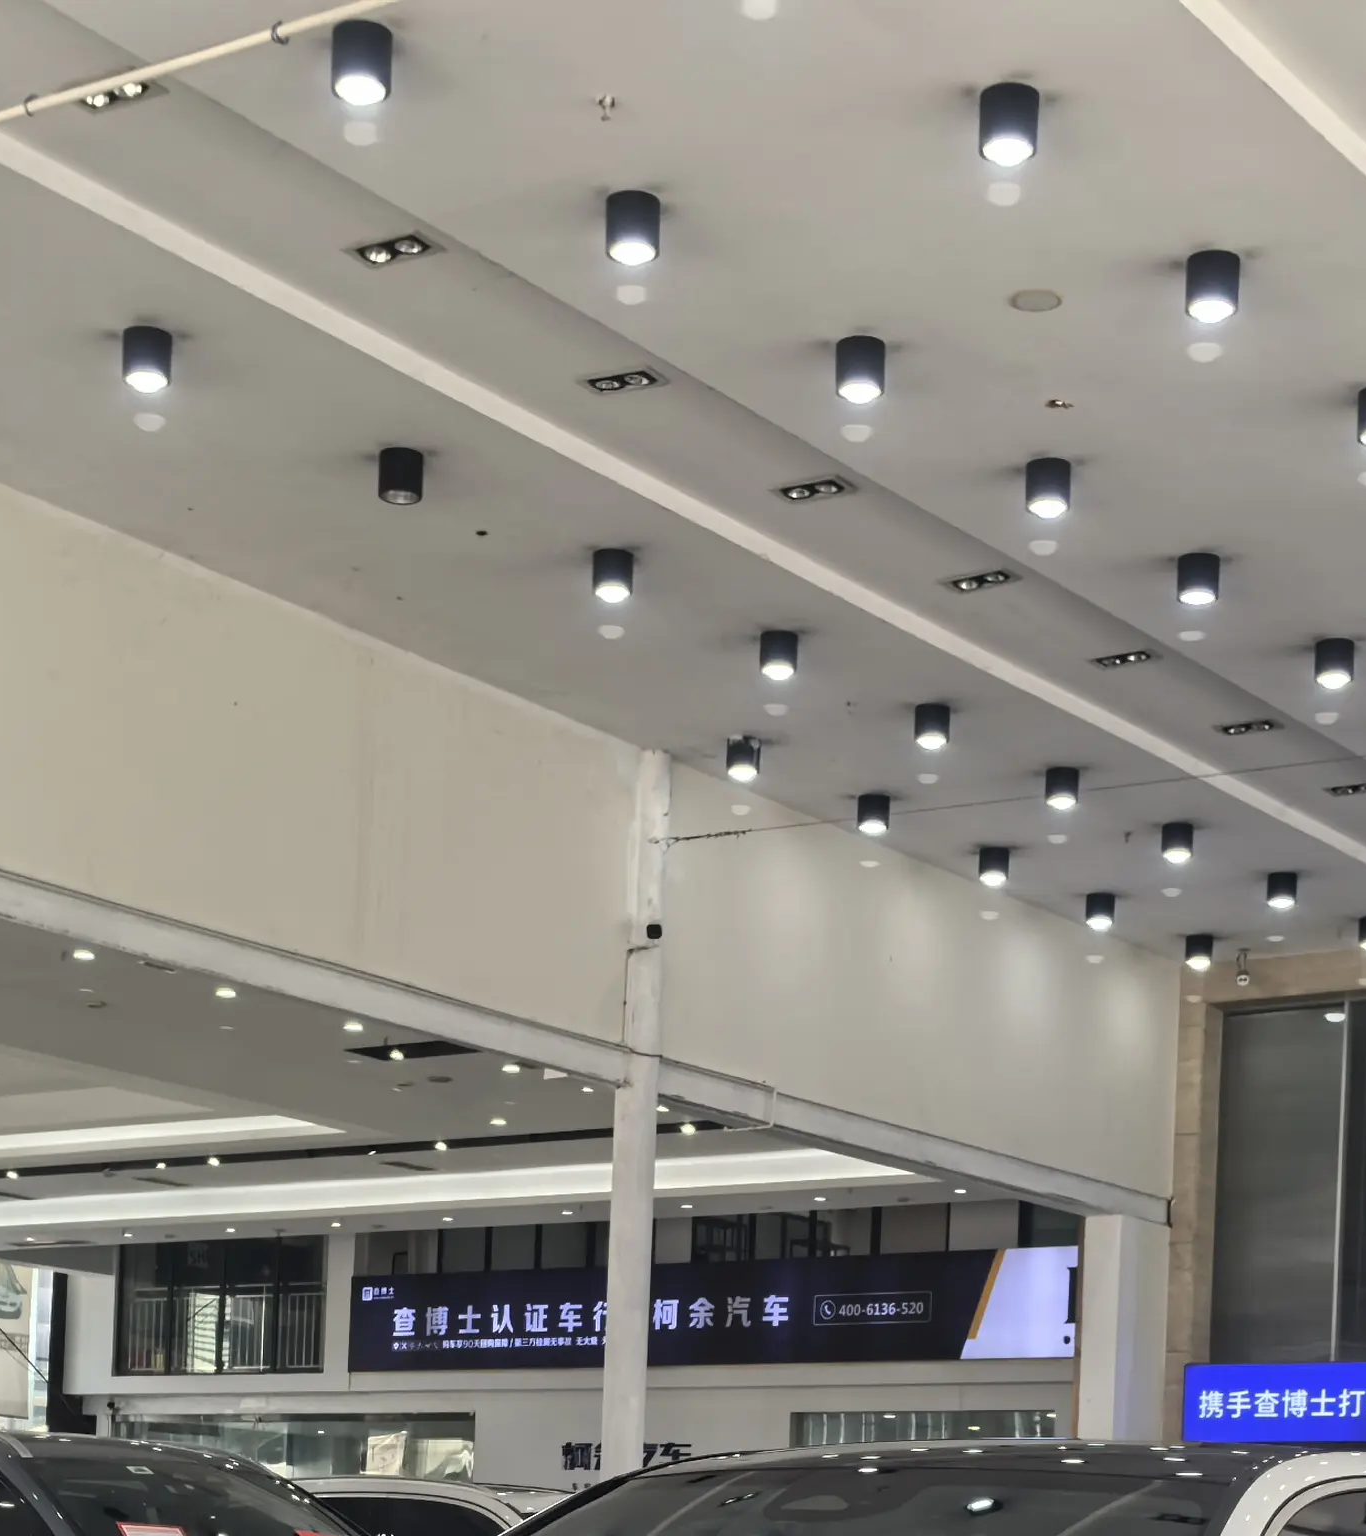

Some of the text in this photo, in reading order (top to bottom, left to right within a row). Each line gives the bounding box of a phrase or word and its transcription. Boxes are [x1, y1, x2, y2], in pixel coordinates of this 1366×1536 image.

[652, 1294, 789, 1331] 柯余汽车
[838, 1301, 925, 1317] 400-6136-520
